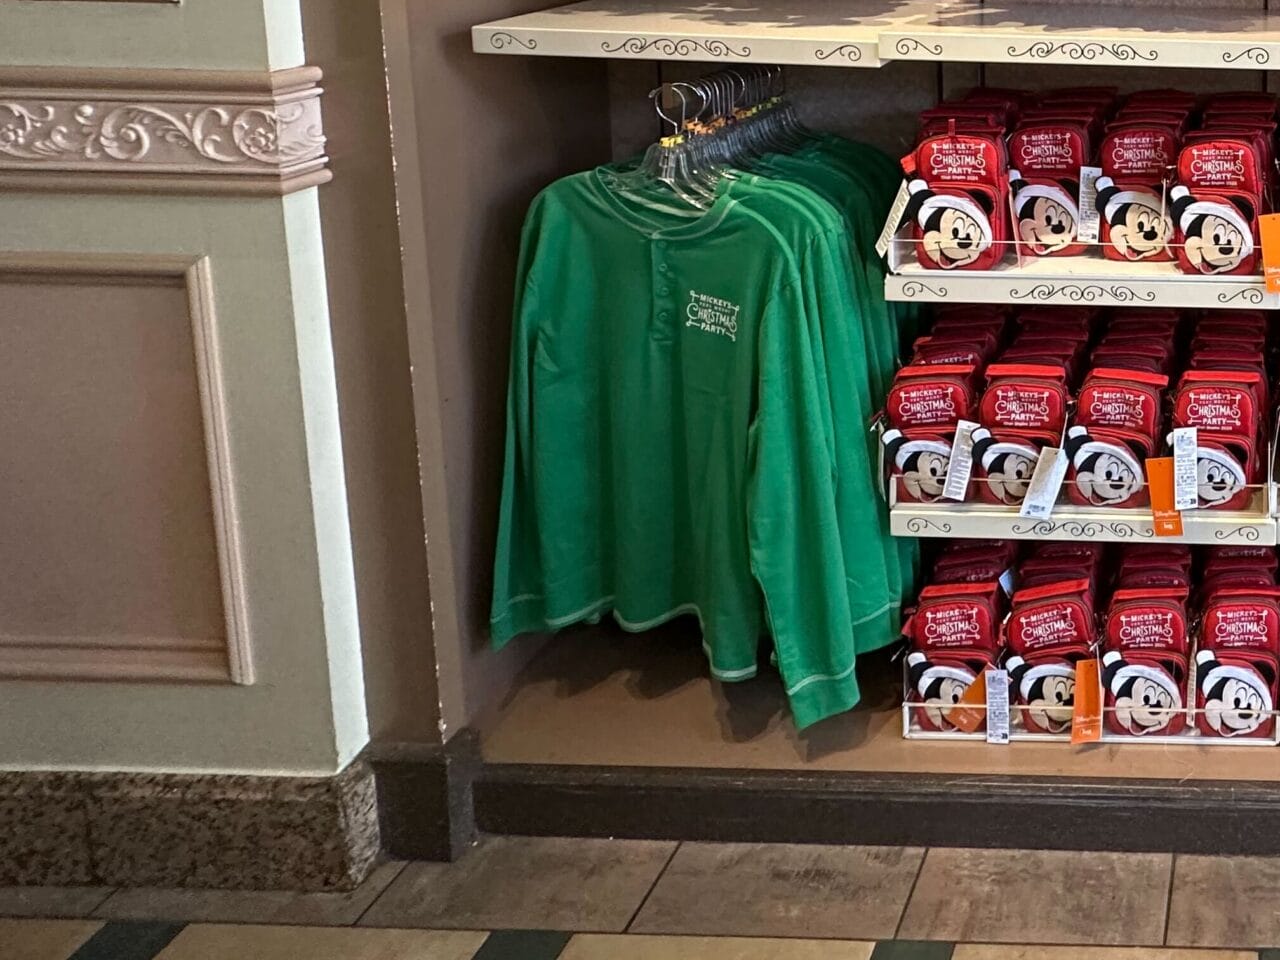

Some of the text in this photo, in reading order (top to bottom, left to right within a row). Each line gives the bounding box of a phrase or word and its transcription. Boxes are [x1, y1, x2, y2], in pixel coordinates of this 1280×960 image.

[1021, 143, 1073, 159] CHRISTMAS
[1112, 147, 1165, 162] CHRISTMAS
[930, 153, 986, 168] CHRISTMAS
[1191, 159, 1245, 174] CHRISTMAS
[686, 302, 738, 333] CHRISTMAS
[701, 322, 727, 336] PARTY
[899, 398, 955, 416] CHRISTMAS
[995, 400, 1049, 414] CHRISTMAS
[1090, 402, 1144, 418] CHRISTMAS
[1187, 403, 1241, 418] CHRISTMAS
[917, 411, 942, 419] PARTY
[1010, 413, 1035, 421] PARTY
[925, 620, 980, 638] CHRISTMAS
[1021, 619, 1075, 641] CHRISTMAS
[1120, 623, 1173, 639] CHRISTMAS
[1215, 621, 1268, 636] CHRISTMAS
[942, 634, 966, 642] PARTY
[1039, 633, 1063, 643] PARTY
